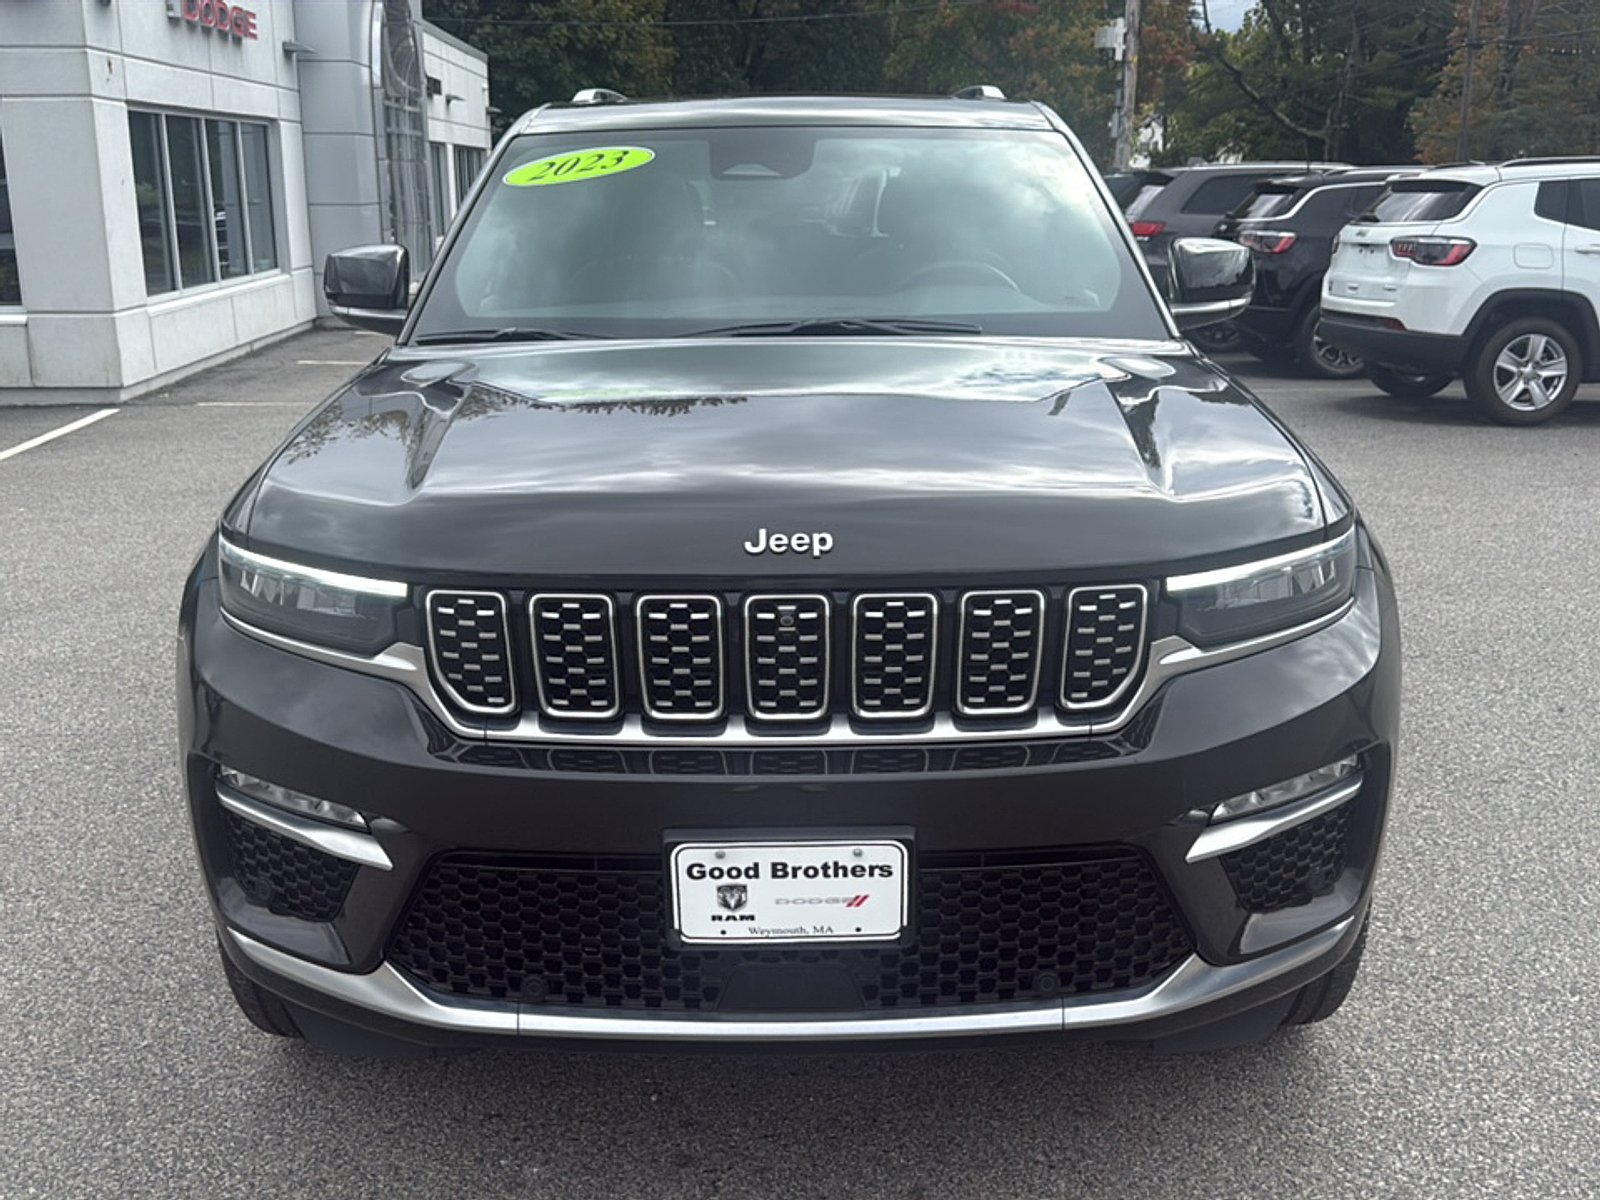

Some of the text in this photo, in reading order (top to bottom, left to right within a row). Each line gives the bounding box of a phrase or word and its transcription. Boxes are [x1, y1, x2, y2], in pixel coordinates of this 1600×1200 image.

[183, 0, 258, 40] DODGE
[526, 150, 630, 182] 2023
[743, 528, 834, 558] Jeep
[686, 860, 894, 880] Good Brothers
[775, 896, 857, 905] DODGE
[710, 914, 756, 922] RAM
[748, 925, 834, 937] Weymouth, MA
